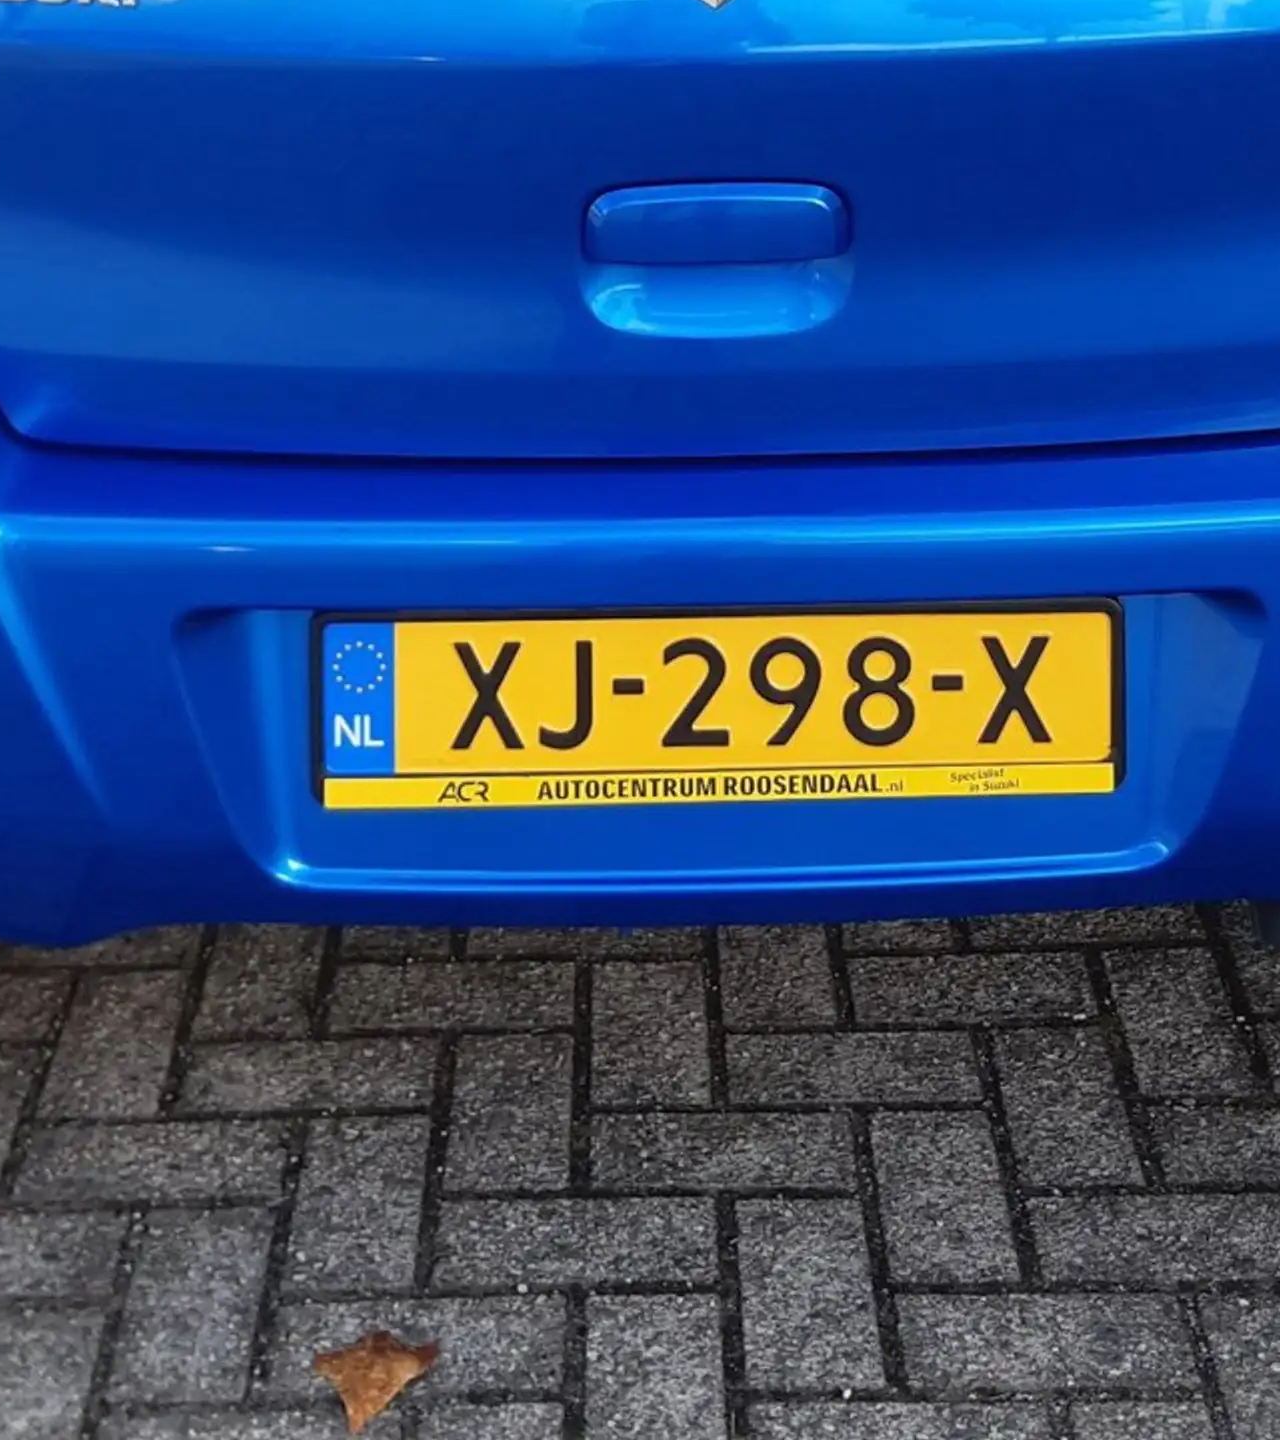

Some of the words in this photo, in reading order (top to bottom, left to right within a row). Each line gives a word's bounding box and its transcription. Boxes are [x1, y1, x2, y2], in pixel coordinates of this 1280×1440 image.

[450, 636, 1053, 750] XJ-298-X
[333, 714, 384, 748] NL
[537, 778, 718, 801] AUTOCENTRUM
